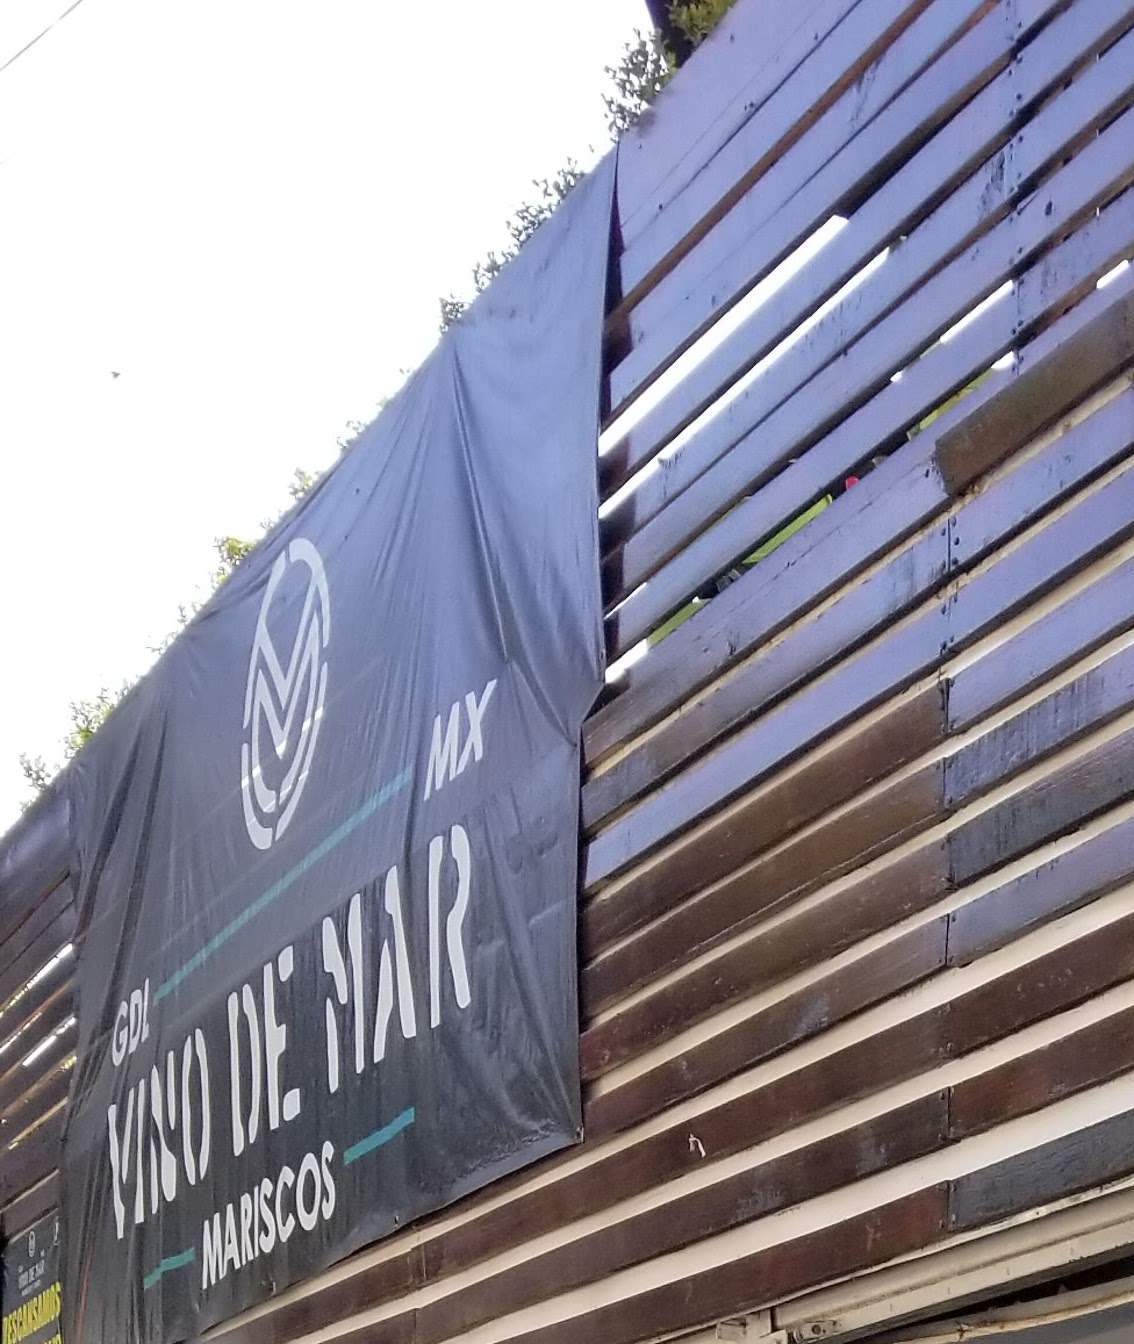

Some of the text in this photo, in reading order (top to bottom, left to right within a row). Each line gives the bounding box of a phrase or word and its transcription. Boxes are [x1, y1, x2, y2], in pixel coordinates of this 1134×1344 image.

[424, 680, 497, 800] MX
[108, 824, 471, 1239] VINO DE MAR
[112, 977, 149, 1066] GDL
[202, 1141, 336, 1289] MARISCOS
